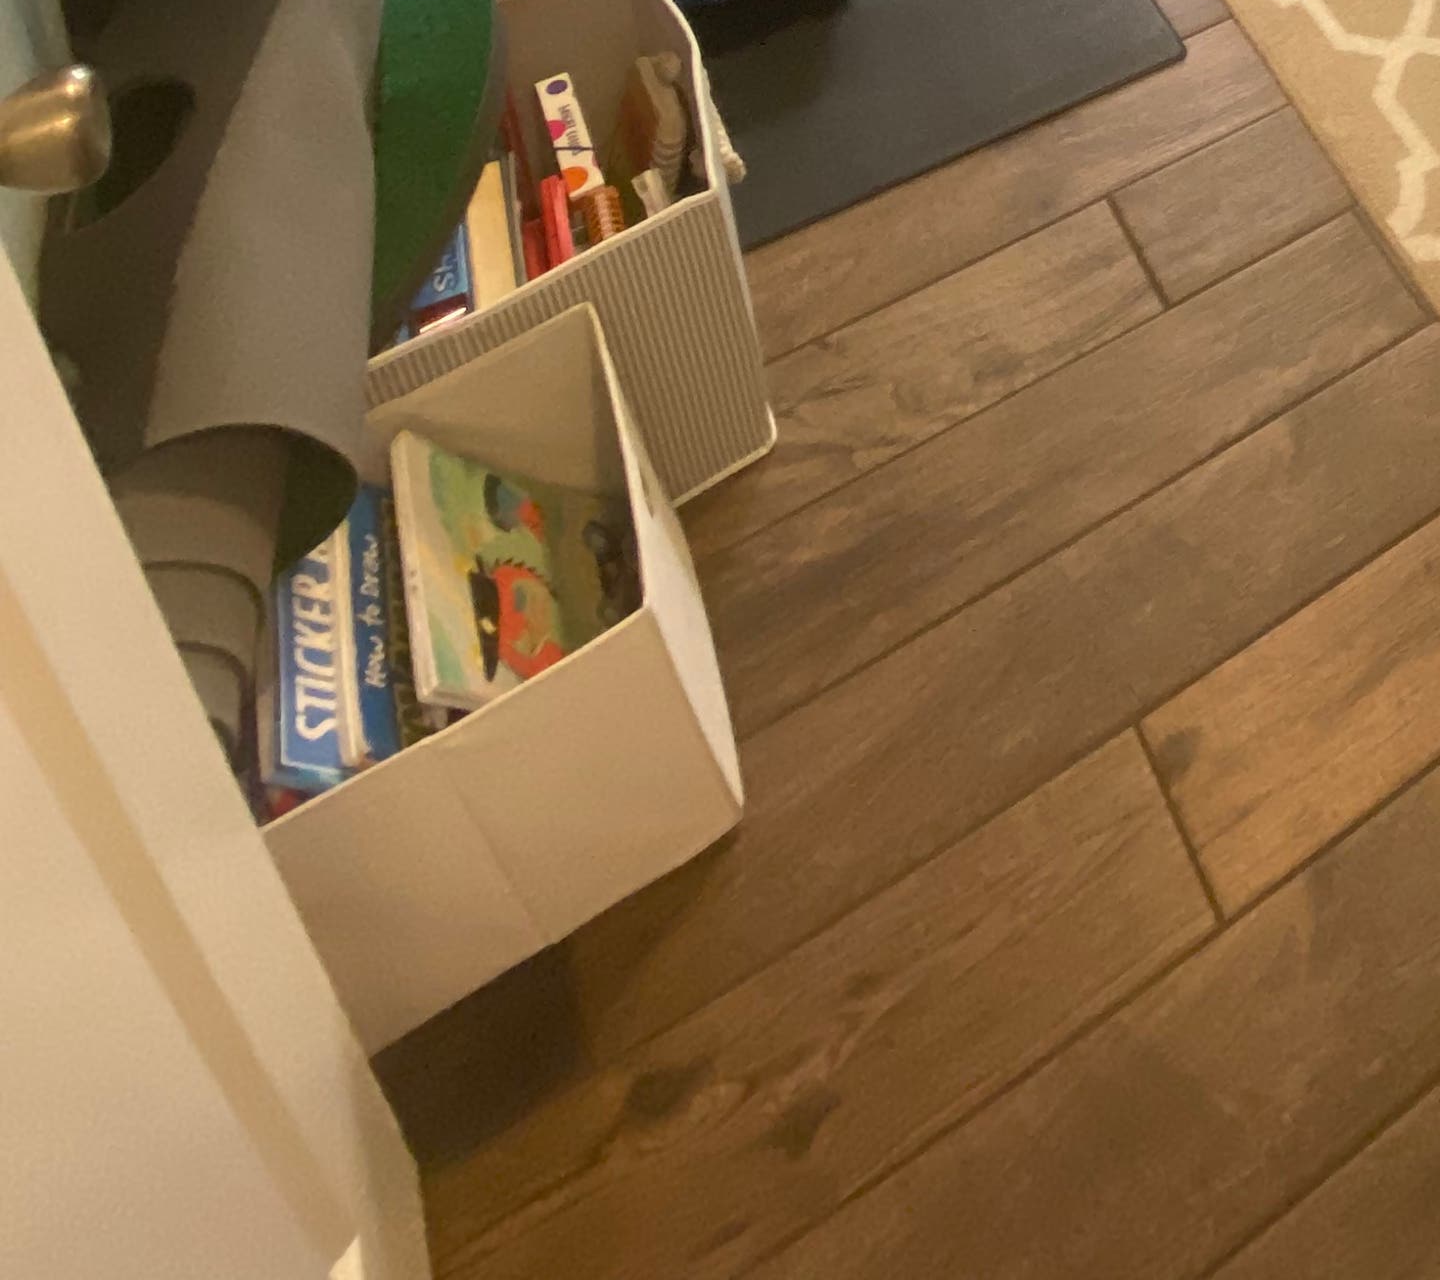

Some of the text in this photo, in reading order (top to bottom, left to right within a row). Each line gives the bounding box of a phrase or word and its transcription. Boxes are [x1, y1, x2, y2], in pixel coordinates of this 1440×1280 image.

[291, 574, 338, 741] STICKER
[356, 534, 387, 689] How to Draw
